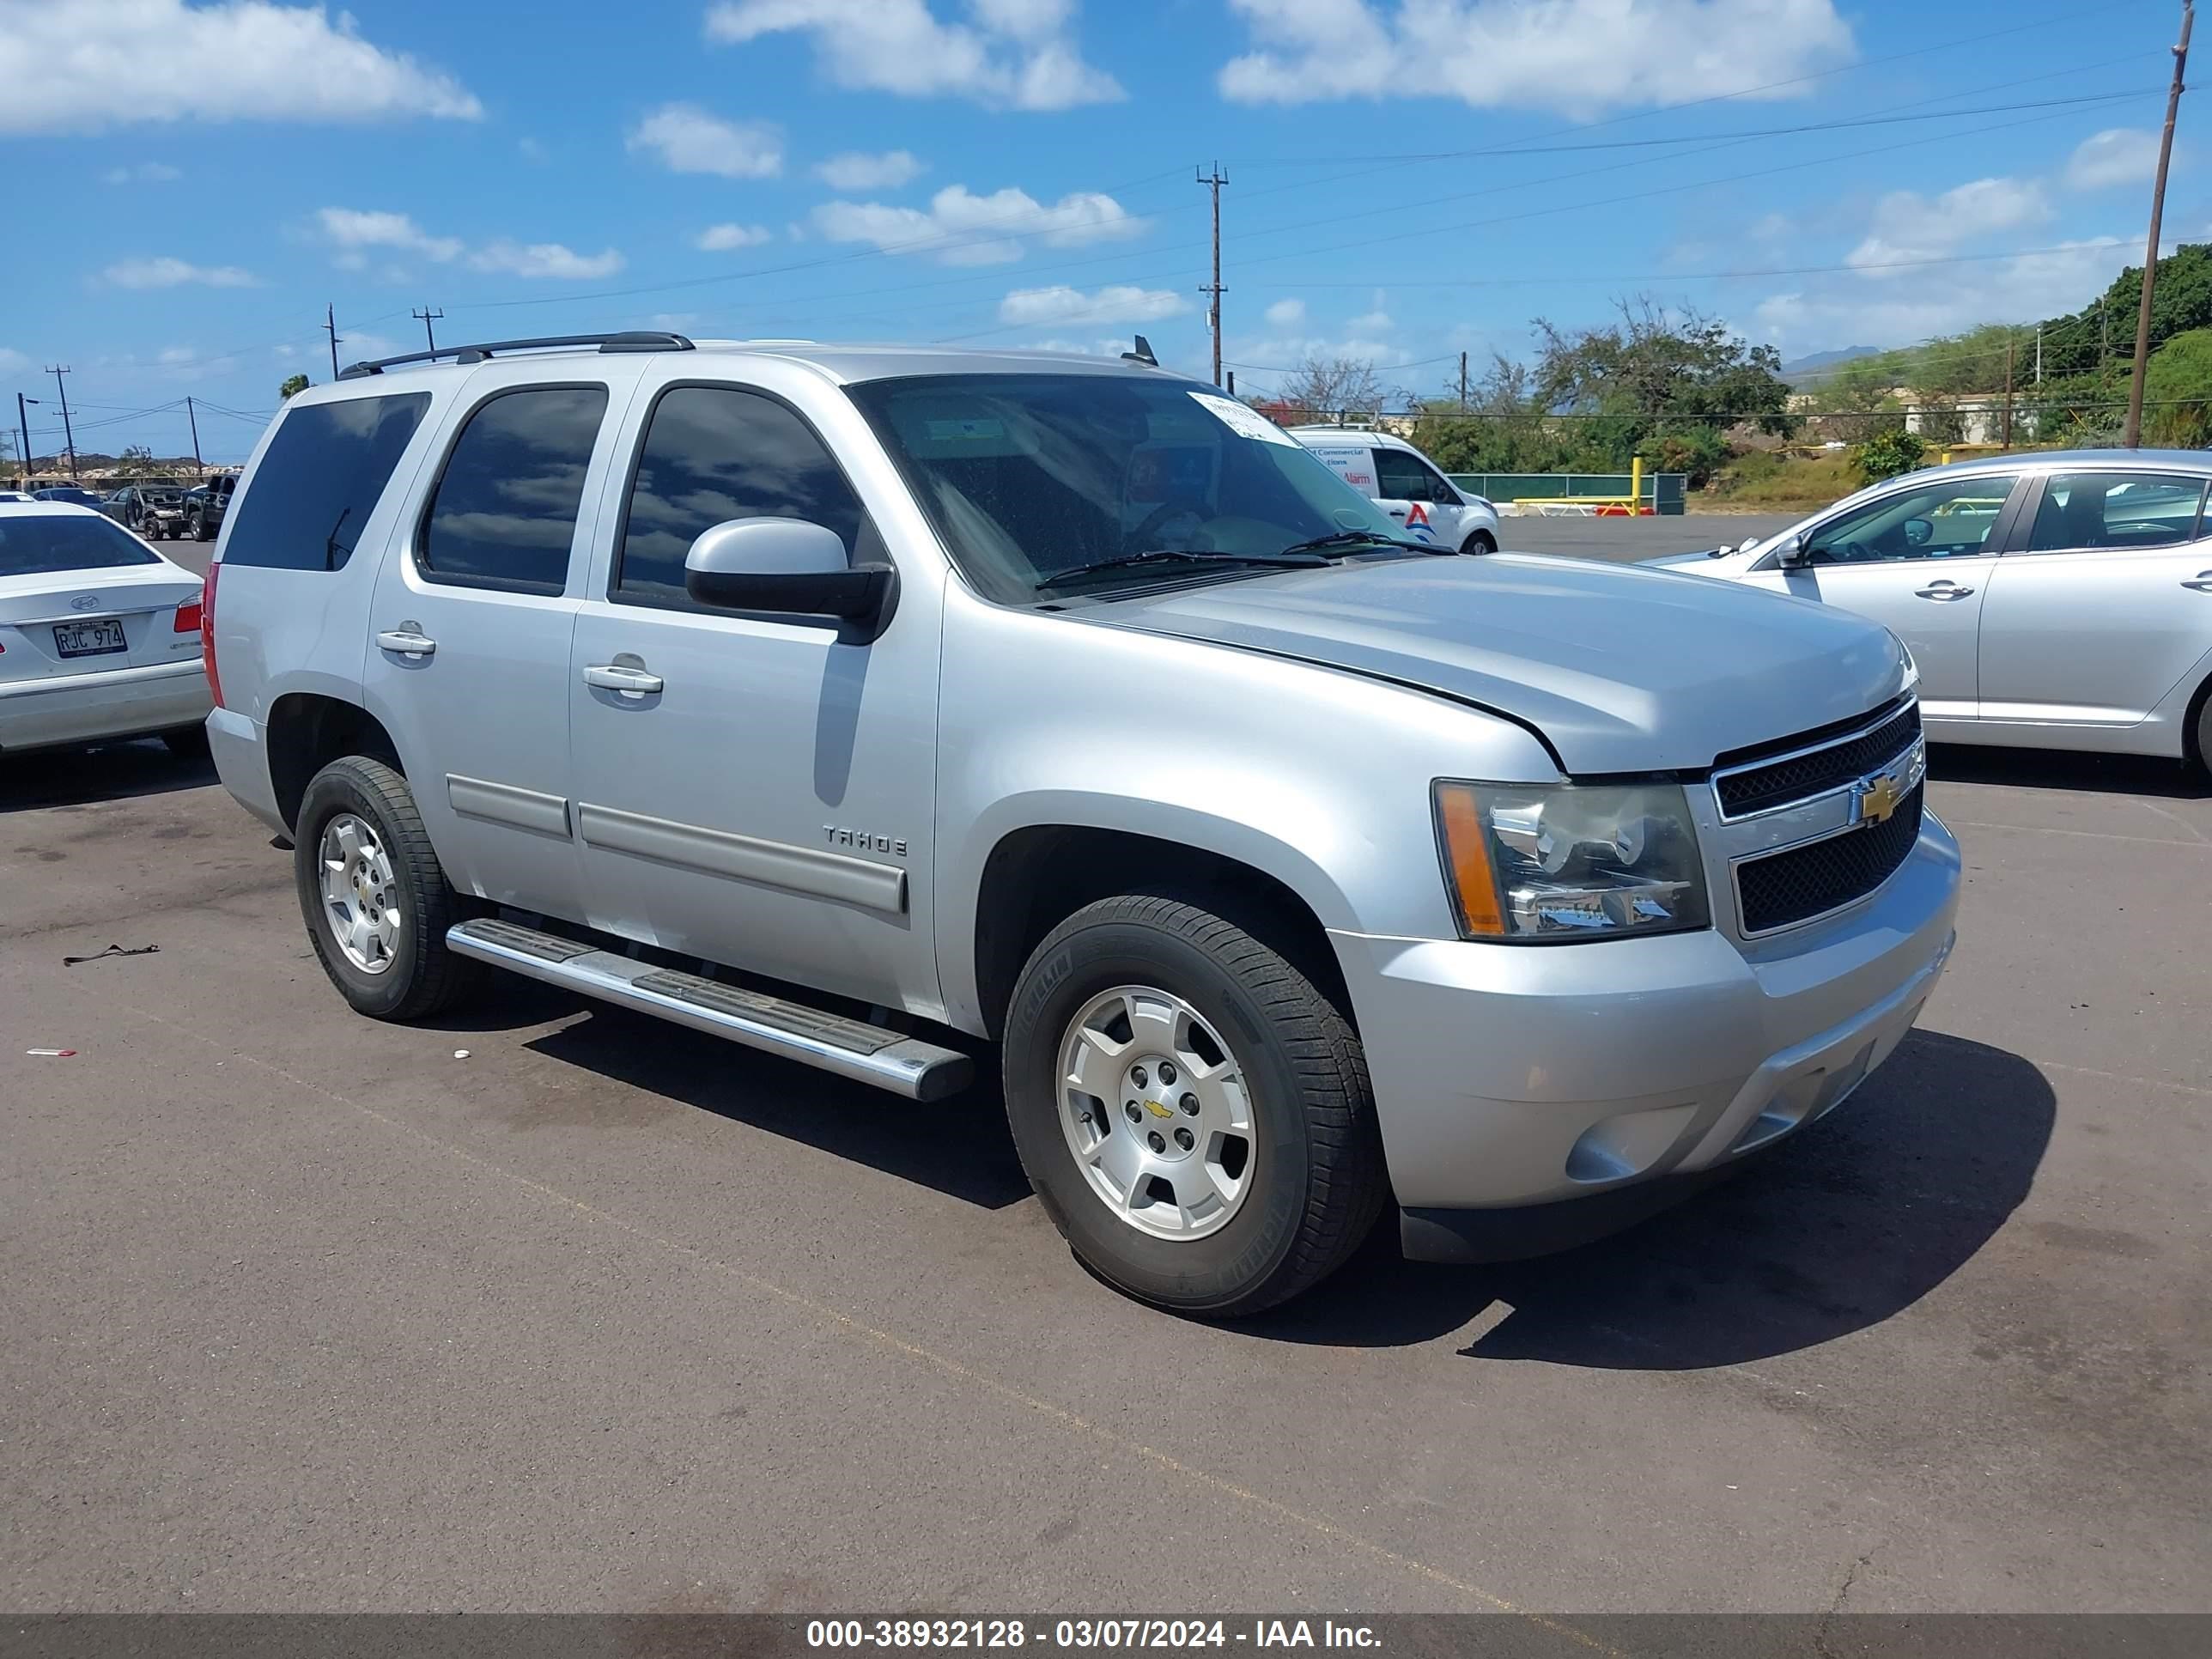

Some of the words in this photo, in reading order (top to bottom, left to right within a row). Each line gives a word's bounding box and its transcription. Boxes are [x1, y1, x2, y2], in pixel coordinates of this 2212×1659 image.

[58, 631, 88, 650] RJC
[94, 628, 122, 646] 974
[823, 824, 908, 857] TAHOE
